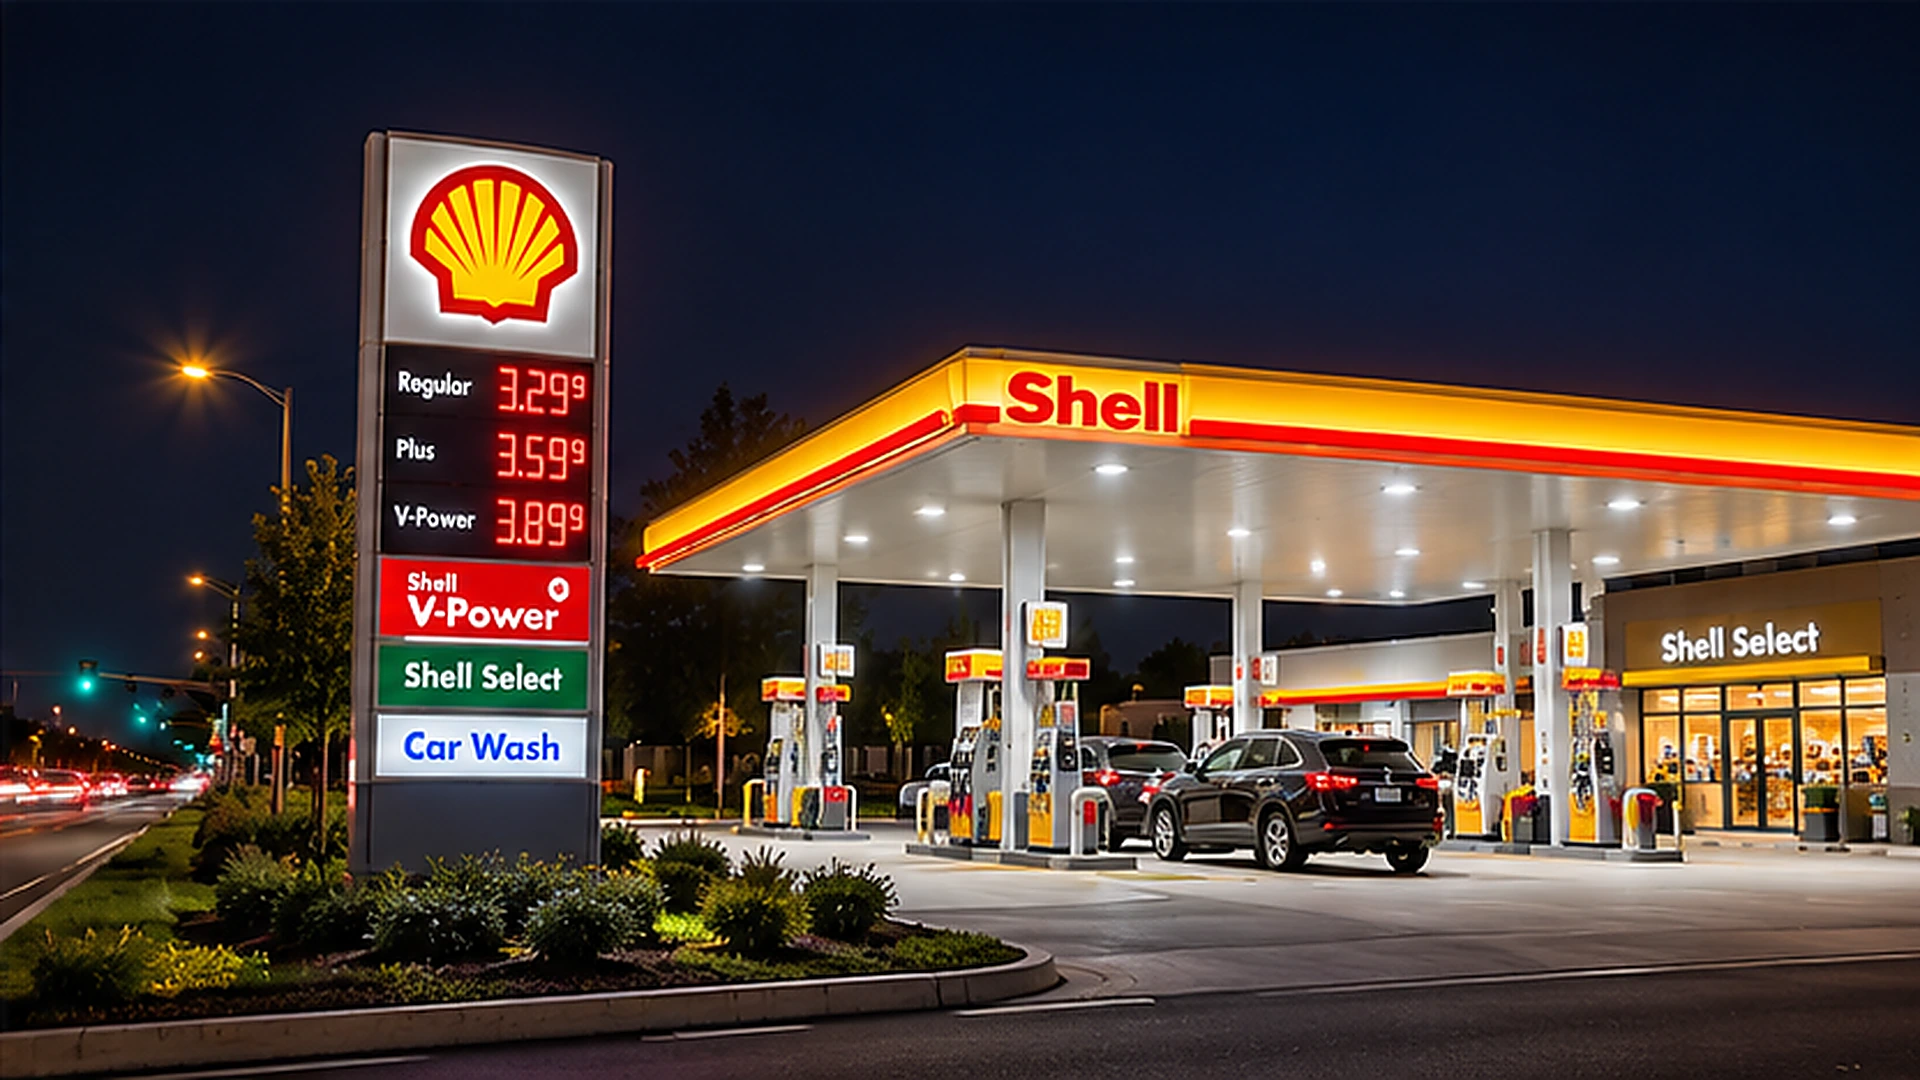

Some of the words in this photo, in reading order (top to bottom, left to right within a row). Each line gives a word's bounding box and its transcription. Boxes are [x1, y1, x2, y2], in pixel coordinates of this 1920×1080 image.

[1005, 370, 1178, 433] Shell
[396, 437, 435, 461] Plus
[393, 504, 476, 530] V-Power
[407, 594, 560, 631] V-Power
[1661, 625, 1725, 663] Shell
[1732, 621, 1820, 658] Select
[404, 660, 473, 689] Shell
[482, 662, 563, 692] Select
[404, 731, 462, 761] Car
[471, 732, 560, 761] Wash
